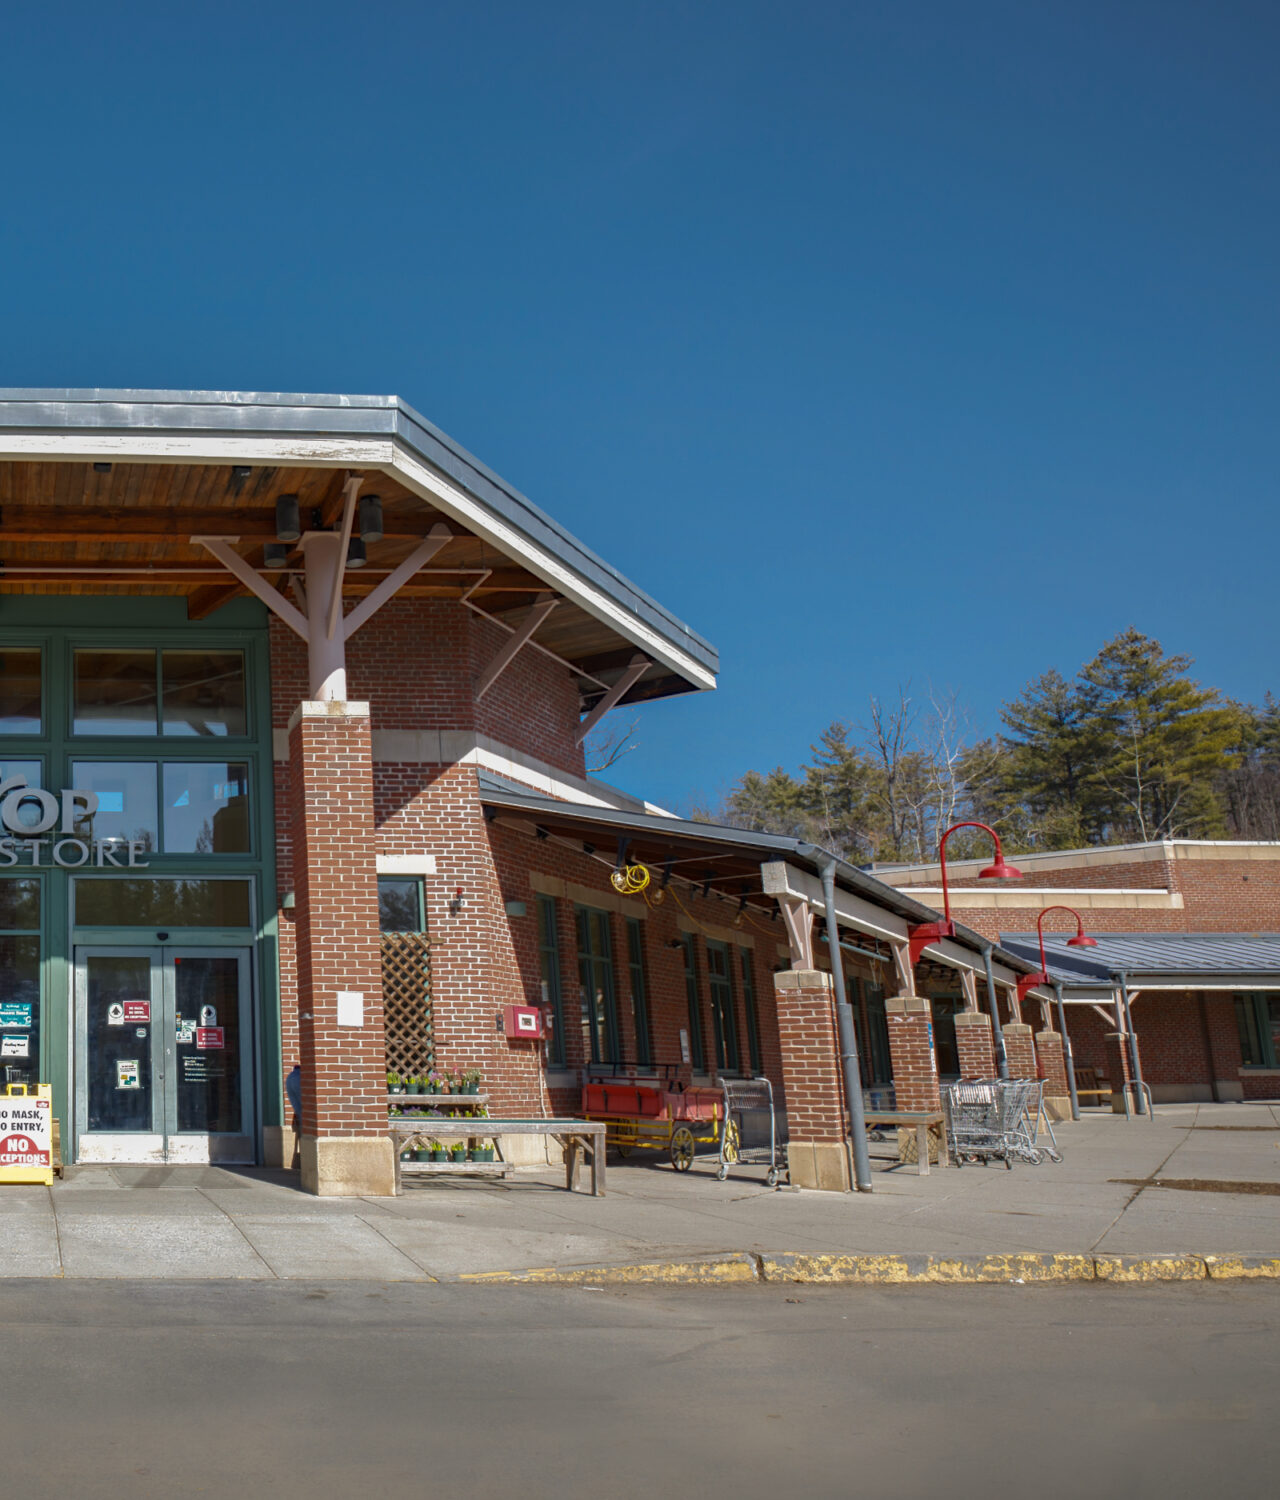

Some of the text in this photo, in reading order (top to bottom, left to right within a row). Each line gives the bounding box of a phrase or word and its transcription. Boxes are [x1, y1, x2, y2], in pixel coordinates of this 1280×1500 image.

[12, 1110, 43, 1120] MASK,
[11, 1122, 44, 1133] ENTRY,
[7, 1138, 29, 1152] NO
